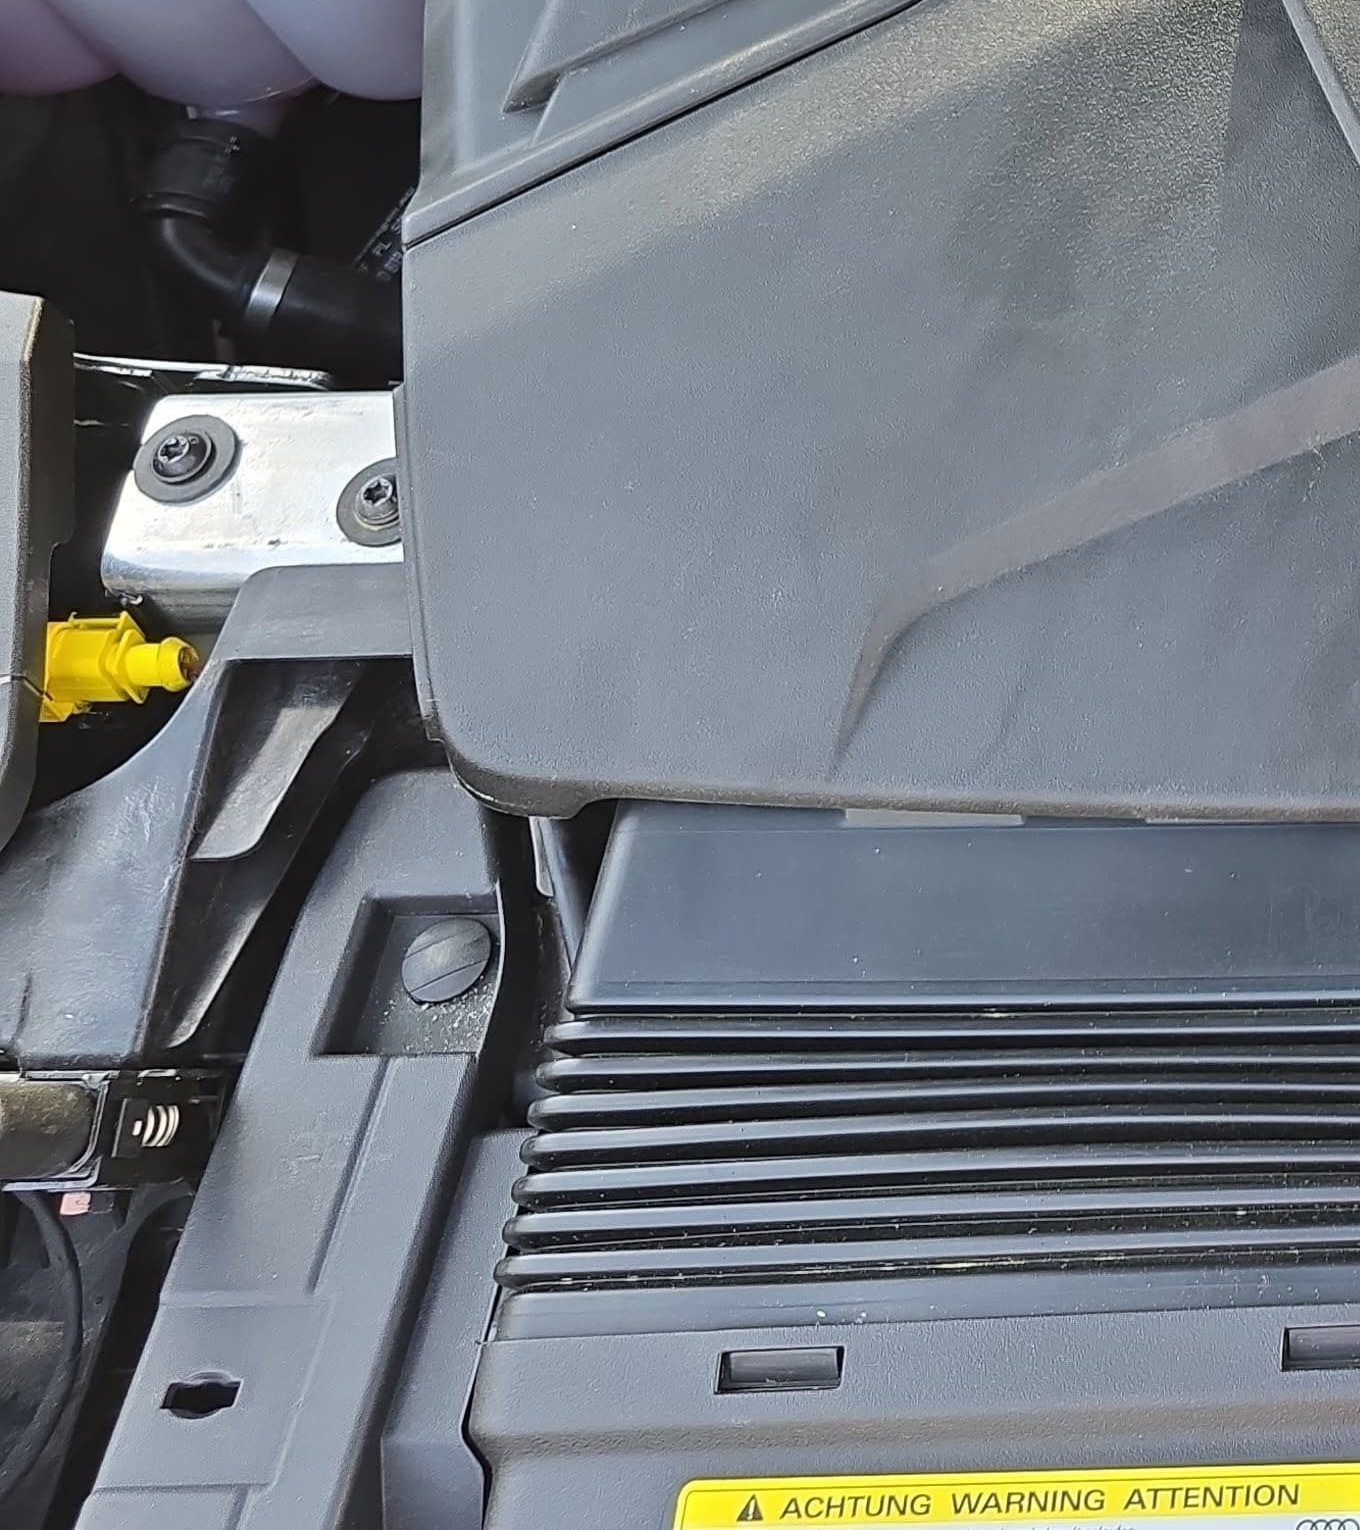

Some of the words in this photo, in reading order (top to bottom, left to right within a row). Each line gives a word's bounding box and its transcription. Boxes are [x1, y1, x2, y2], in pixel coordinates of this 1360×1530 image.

[779, 1494, 931, 1520] ACHTUNG
[951, 1488, 1105, 1514] WARNING
[1123, 1483, 1300, 1511] ATTENTION
